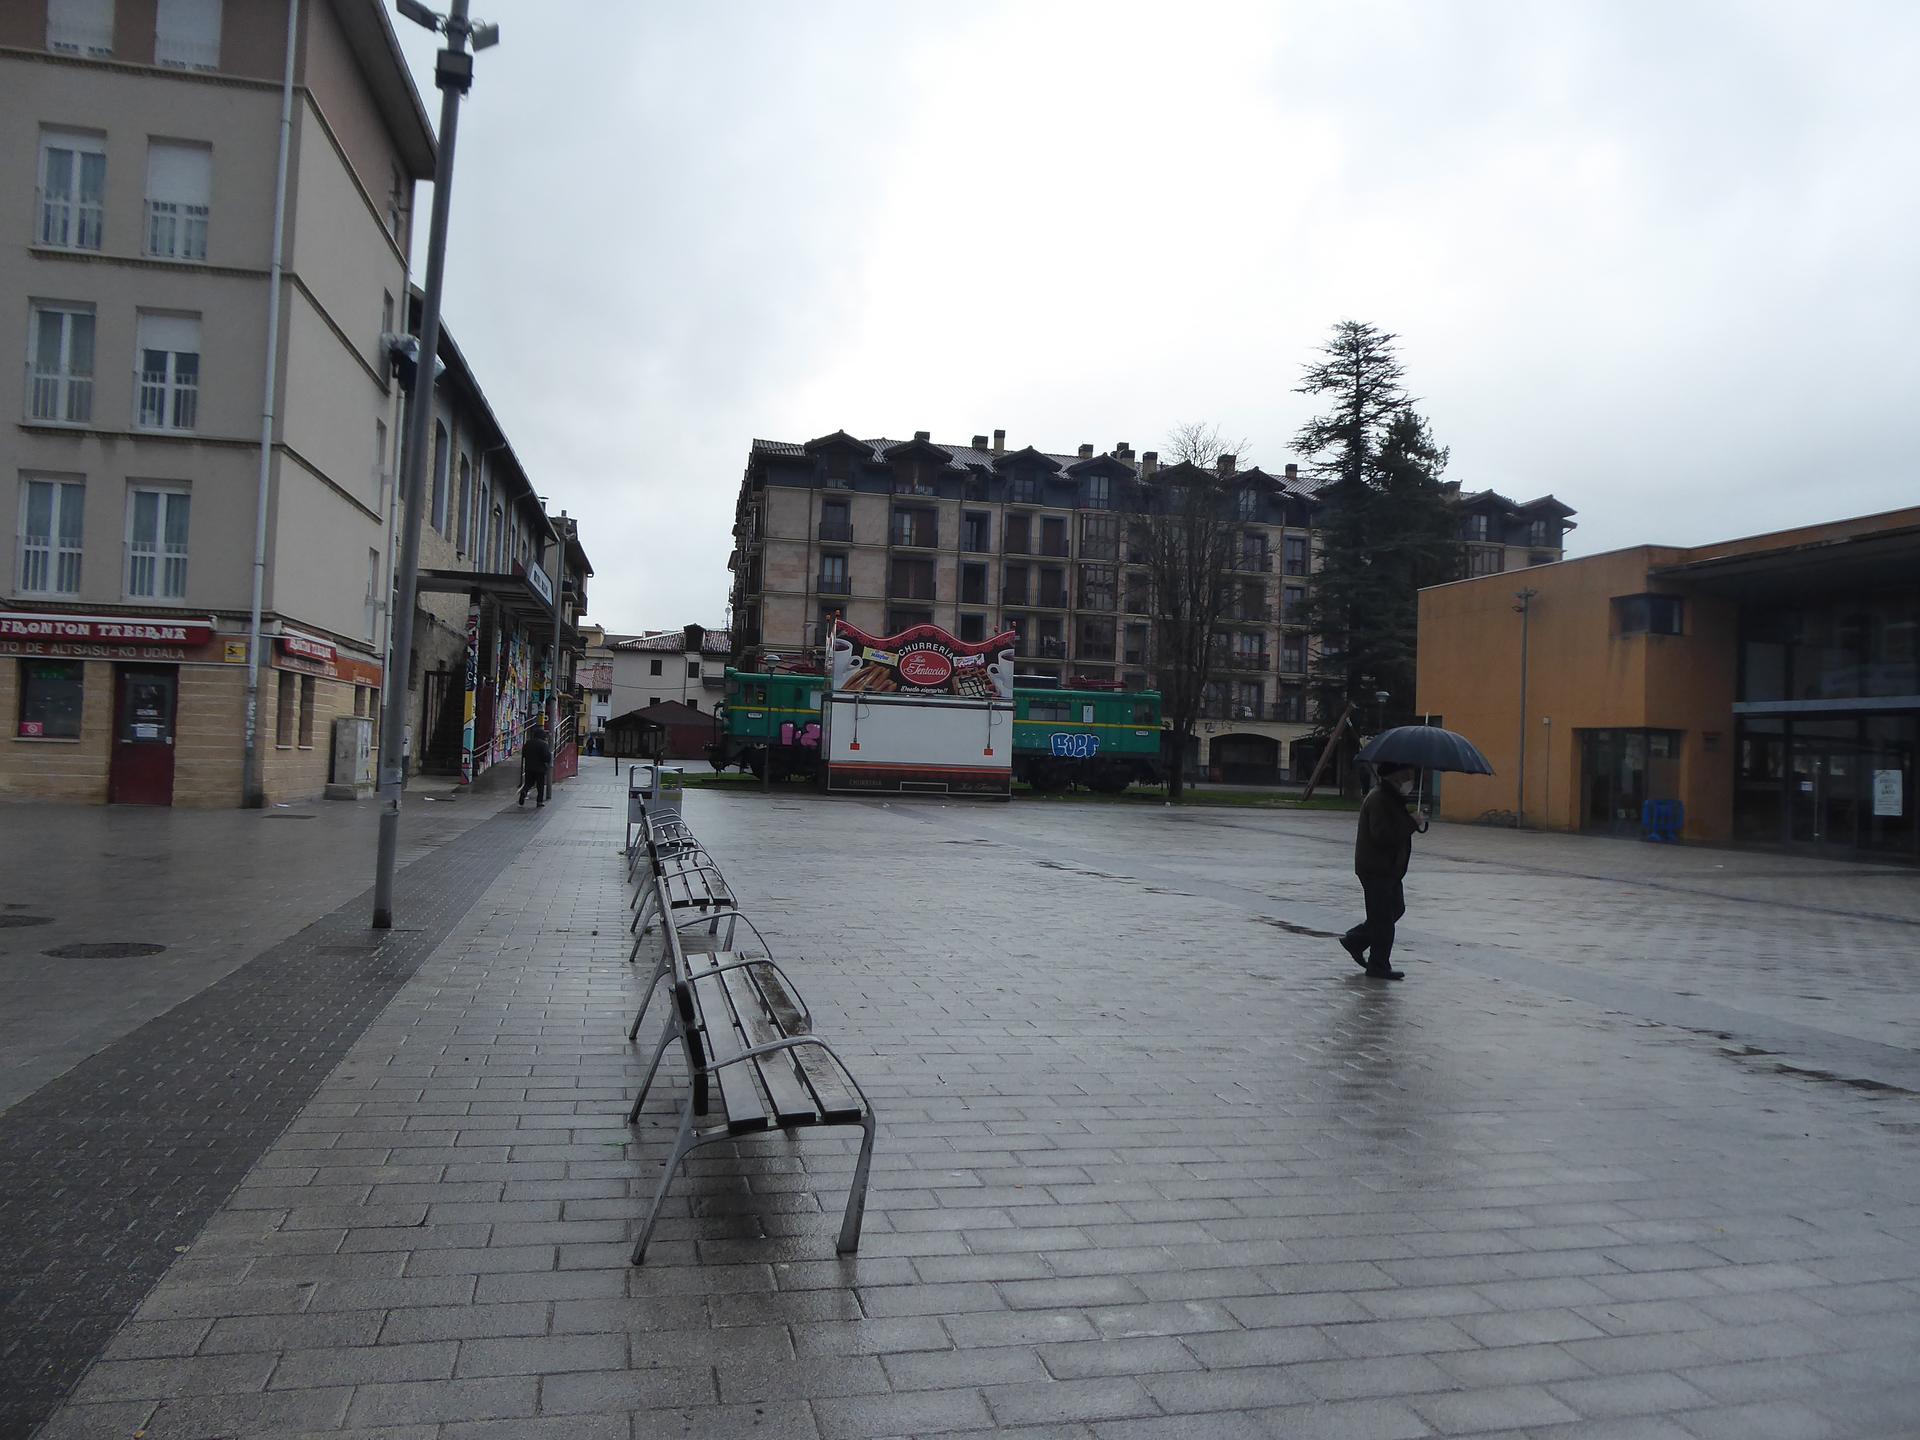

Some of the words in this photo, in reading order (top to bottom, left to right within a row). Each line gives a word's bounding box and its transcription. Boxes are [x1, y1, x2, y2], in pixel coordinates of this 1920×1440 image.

[1, 621, 90, 635] FRONTON
[98, 624, 187, 640] TABERNA
[26, 642, 44, 654] DE
[143, 646, 185, 659] UDALA
[898, 642, 954, 659] CHURRERÍA
